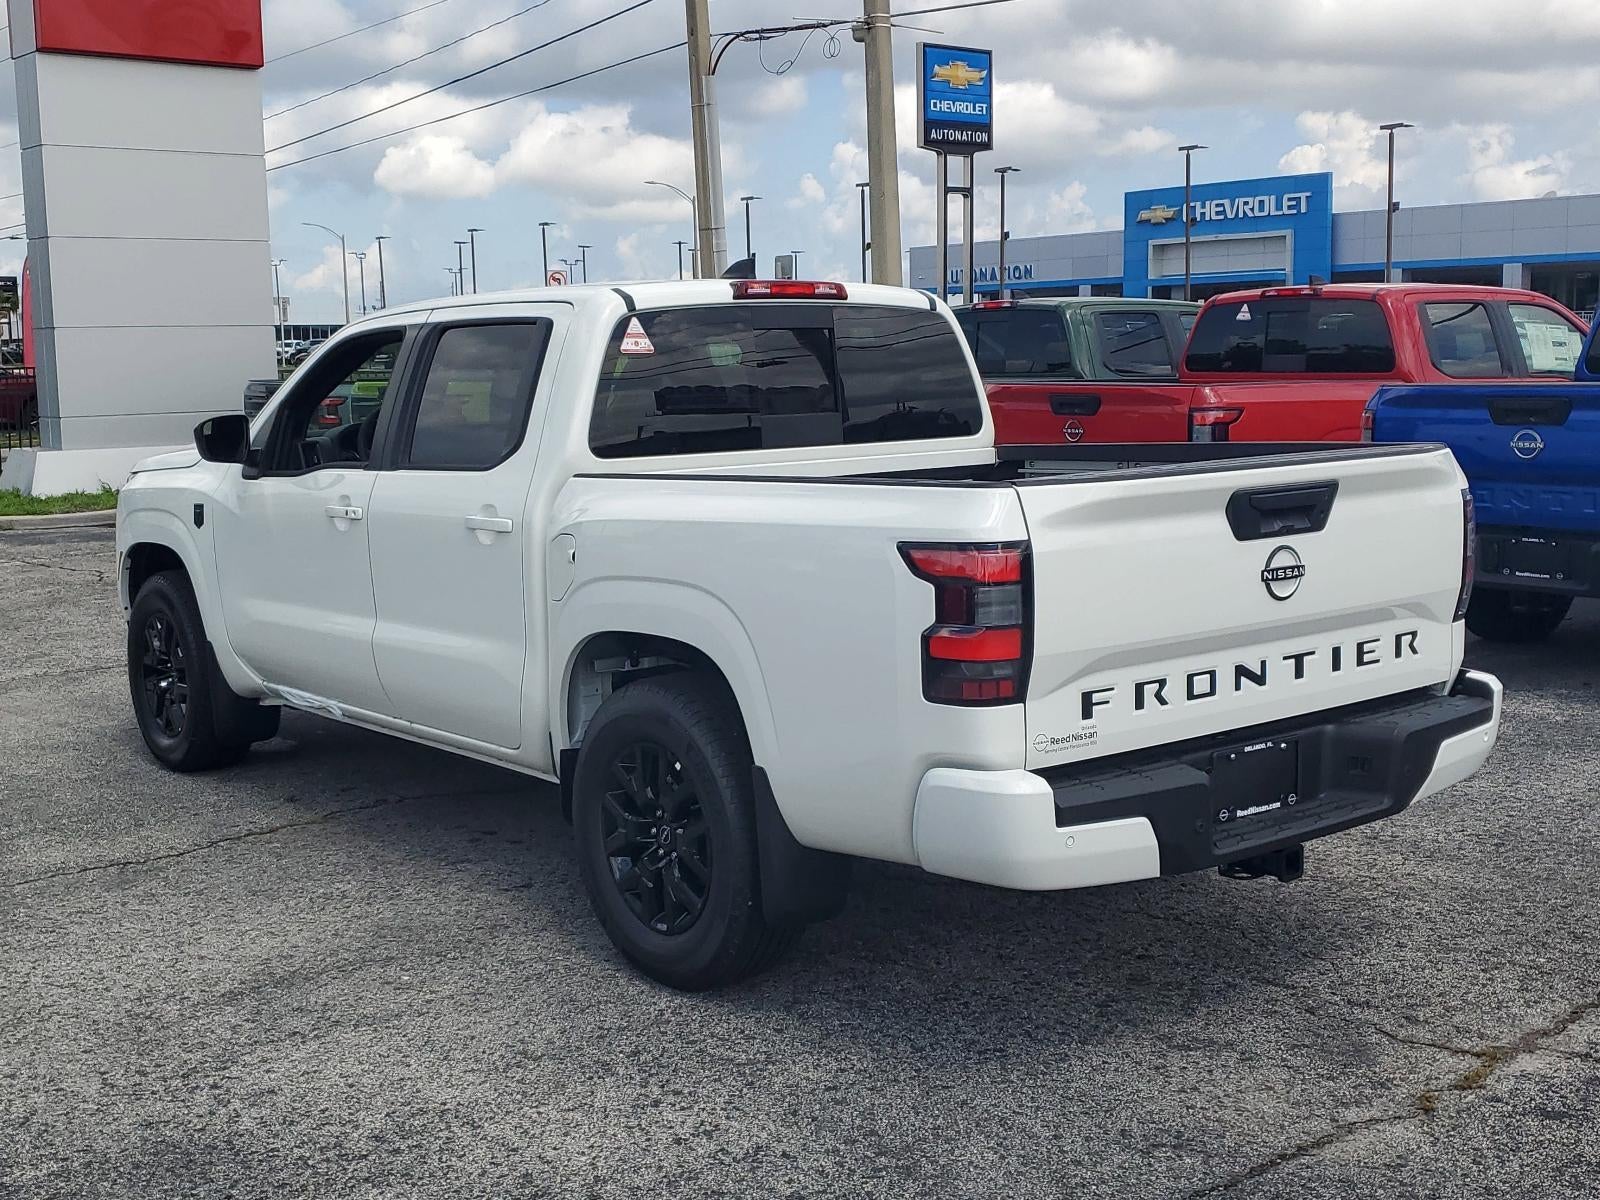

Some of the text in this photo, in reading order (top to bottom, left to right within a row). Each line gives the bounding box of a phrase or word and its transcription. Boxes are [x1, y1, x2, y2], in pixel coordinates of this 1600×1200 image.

[930, 99, 988, 115] CHEVROLET
[930, 129, 988, 143] AUTONATION
[1182, 191, 1313, 223] CHEVROLET
[1510, 441, 1545, 449] NISSAN
[1263, 565, 1305, 580] NISSAN
[1080, 630, 1420, 721] FRONTIER
[1050, 733, 1071, 746] Reed
[1071, 730, 1098, 742] Nissan
[1236, 801, 1281, 818] ReedNissan.com
